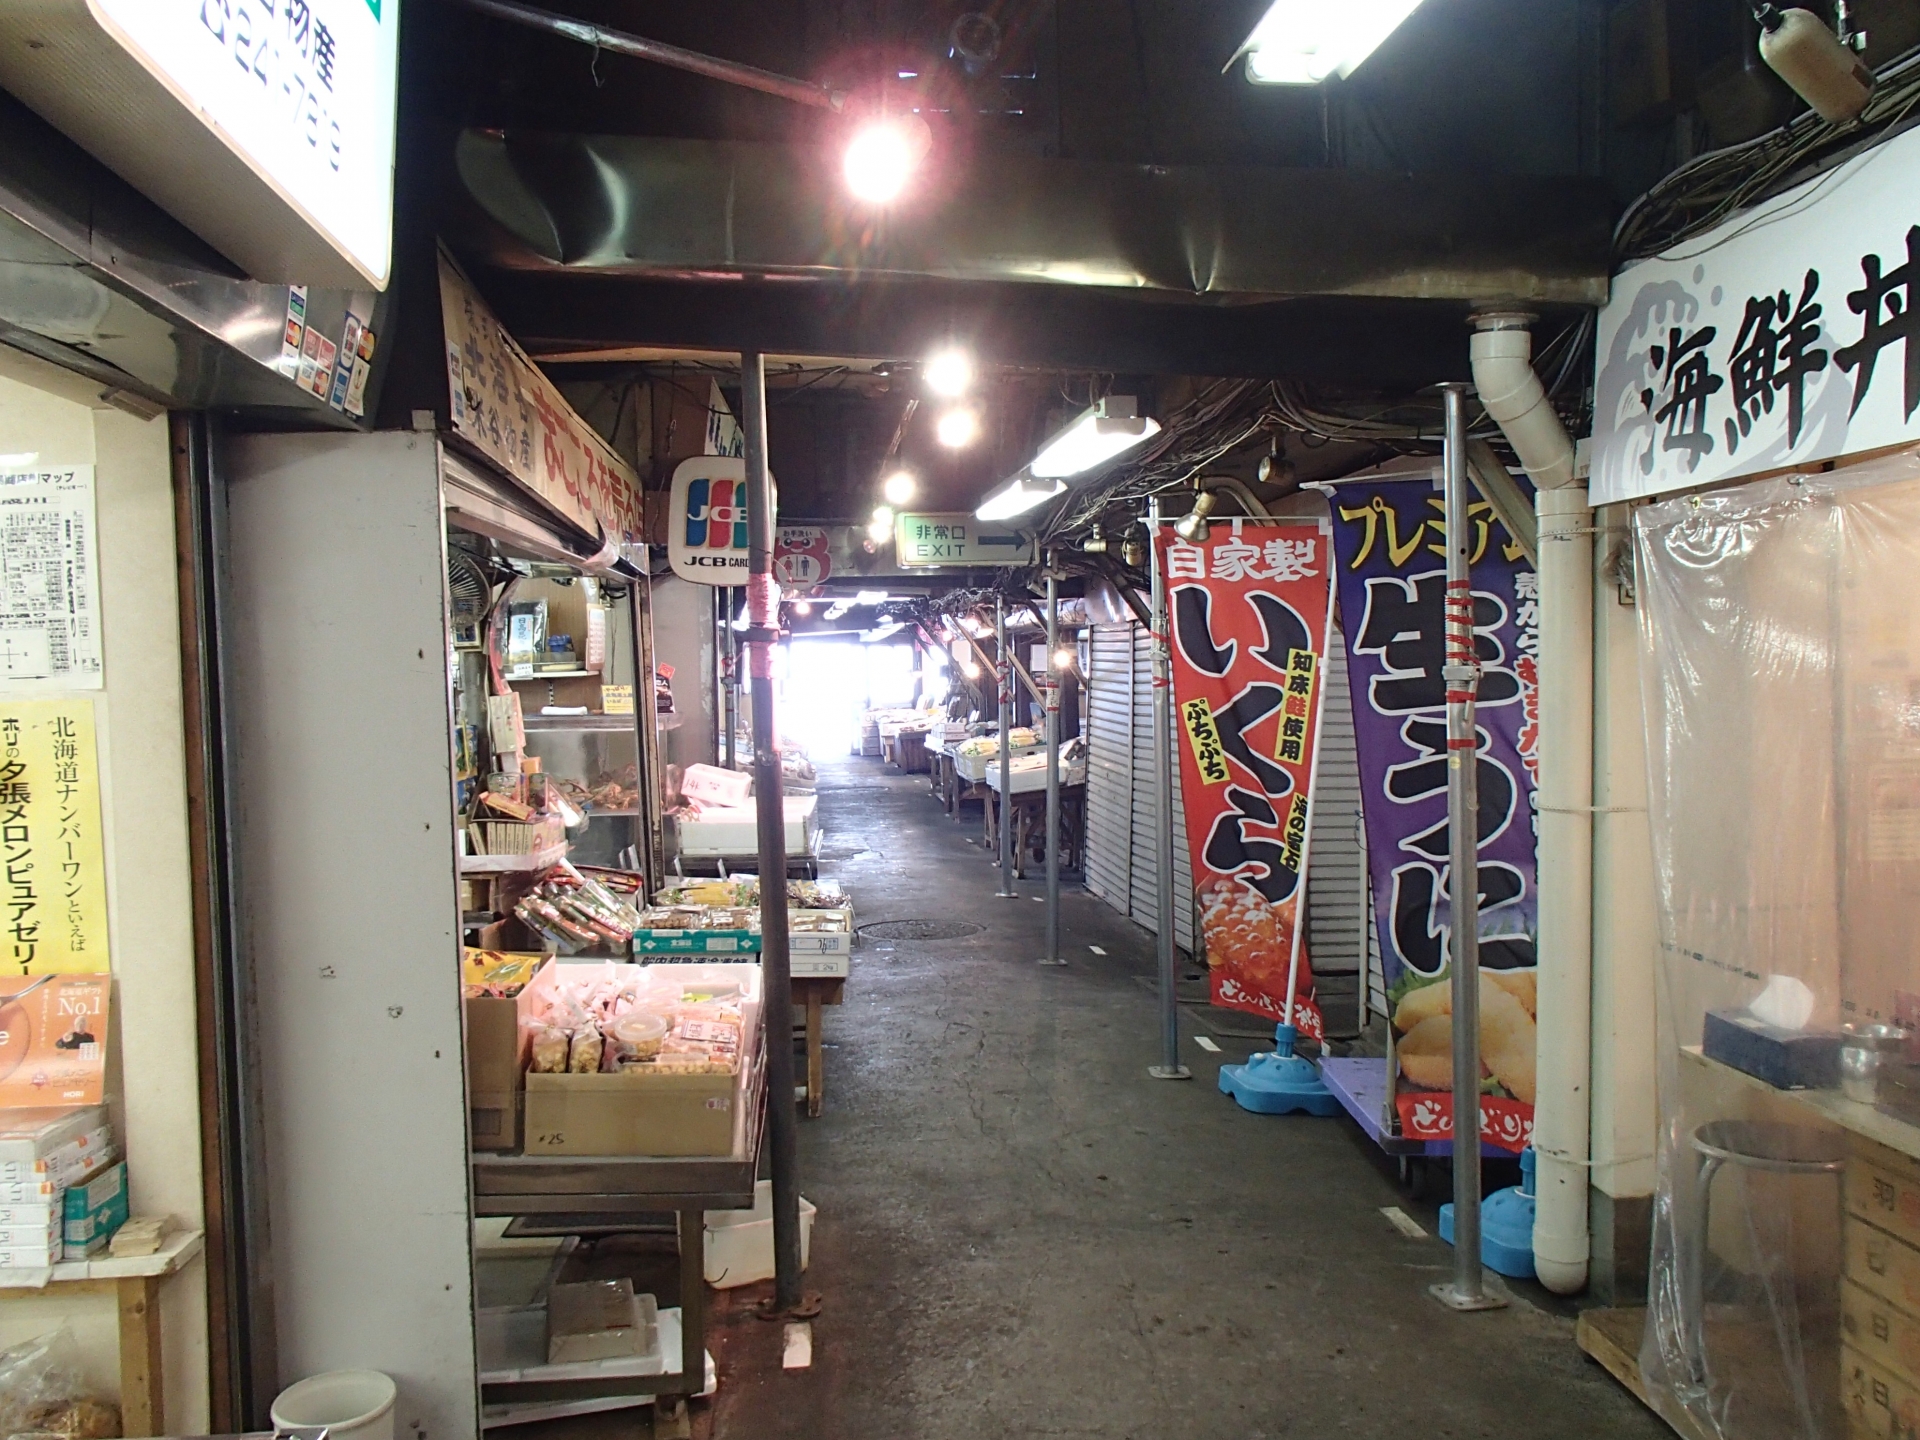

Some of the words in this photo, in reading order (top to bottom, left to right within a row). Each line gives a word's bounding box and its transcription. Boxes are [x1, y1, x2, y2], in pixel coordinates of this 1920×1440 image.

[258, 0, 335, 94] 物産
[1641, 225, 1920, 475] 海鮮丼
[684, 556, 727, 567] JCB
[782, 530, 813, 538] お手洗い
[916, 525, 965, 540] 非常口
[917, 544, 966, 556] EXIT
[1166, 536, 1319, 582] 自家製
[1171, 583, 1312, 906] いくら
[1186, 699, 1226, 781] ぷちぷち
[1279, 651, 1314, 764] 知床鮭使用
[1353, 570, 1538, 978] 生うに
[51, 716, 86, 952] 北海道ナンバーワンといえば
[57, 996, 101, 1016] No.1
